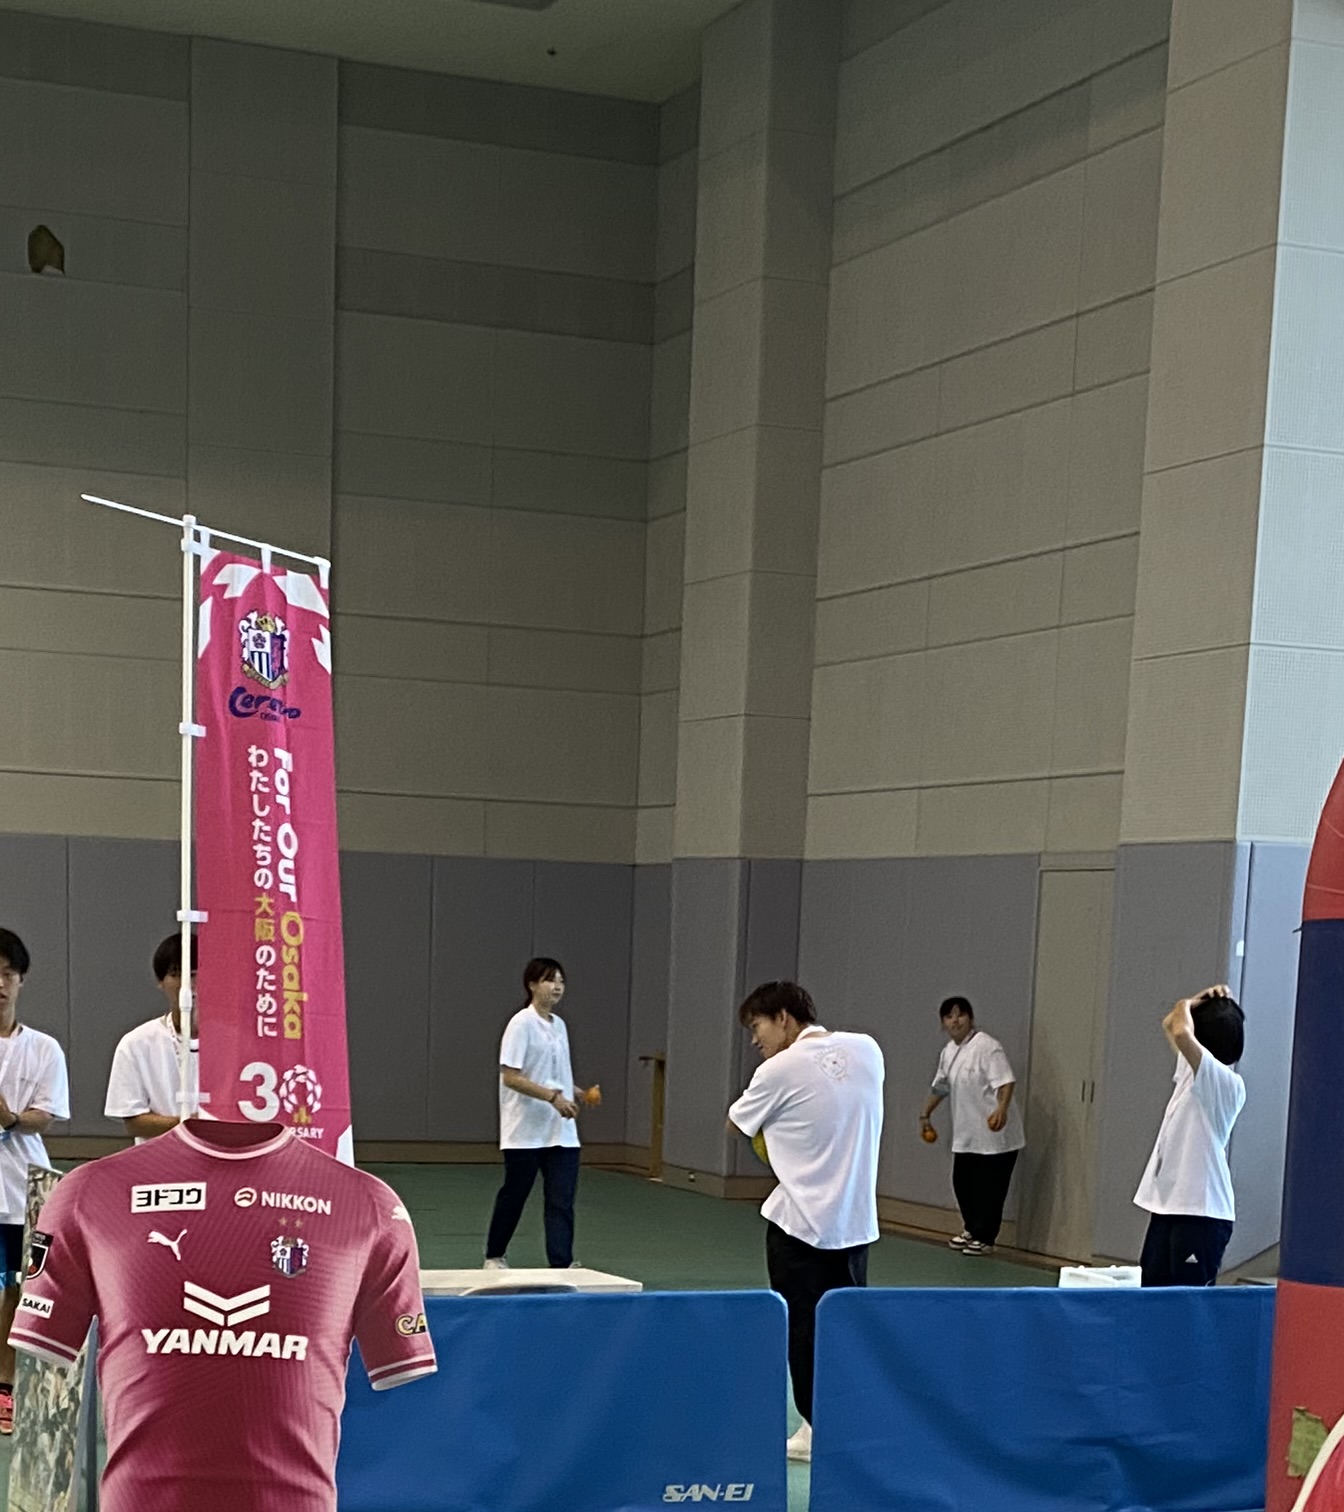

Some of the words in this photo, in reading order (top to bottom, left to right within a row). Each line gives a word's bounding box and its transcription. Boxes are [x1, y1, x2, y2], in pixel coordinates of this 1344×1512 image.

[273, 747, 293, 815] For
[276, 822, 298, 902] Our
[280, 911, 308, 1039] Osaka
[136, 1187, 202, 1207] ヨドコウ
[261, 1191, 331, 1216] NIKKON
[142, 1328, 309, 1360] YANMAR
[662, 1483, 754, 1502] SAN-EI
